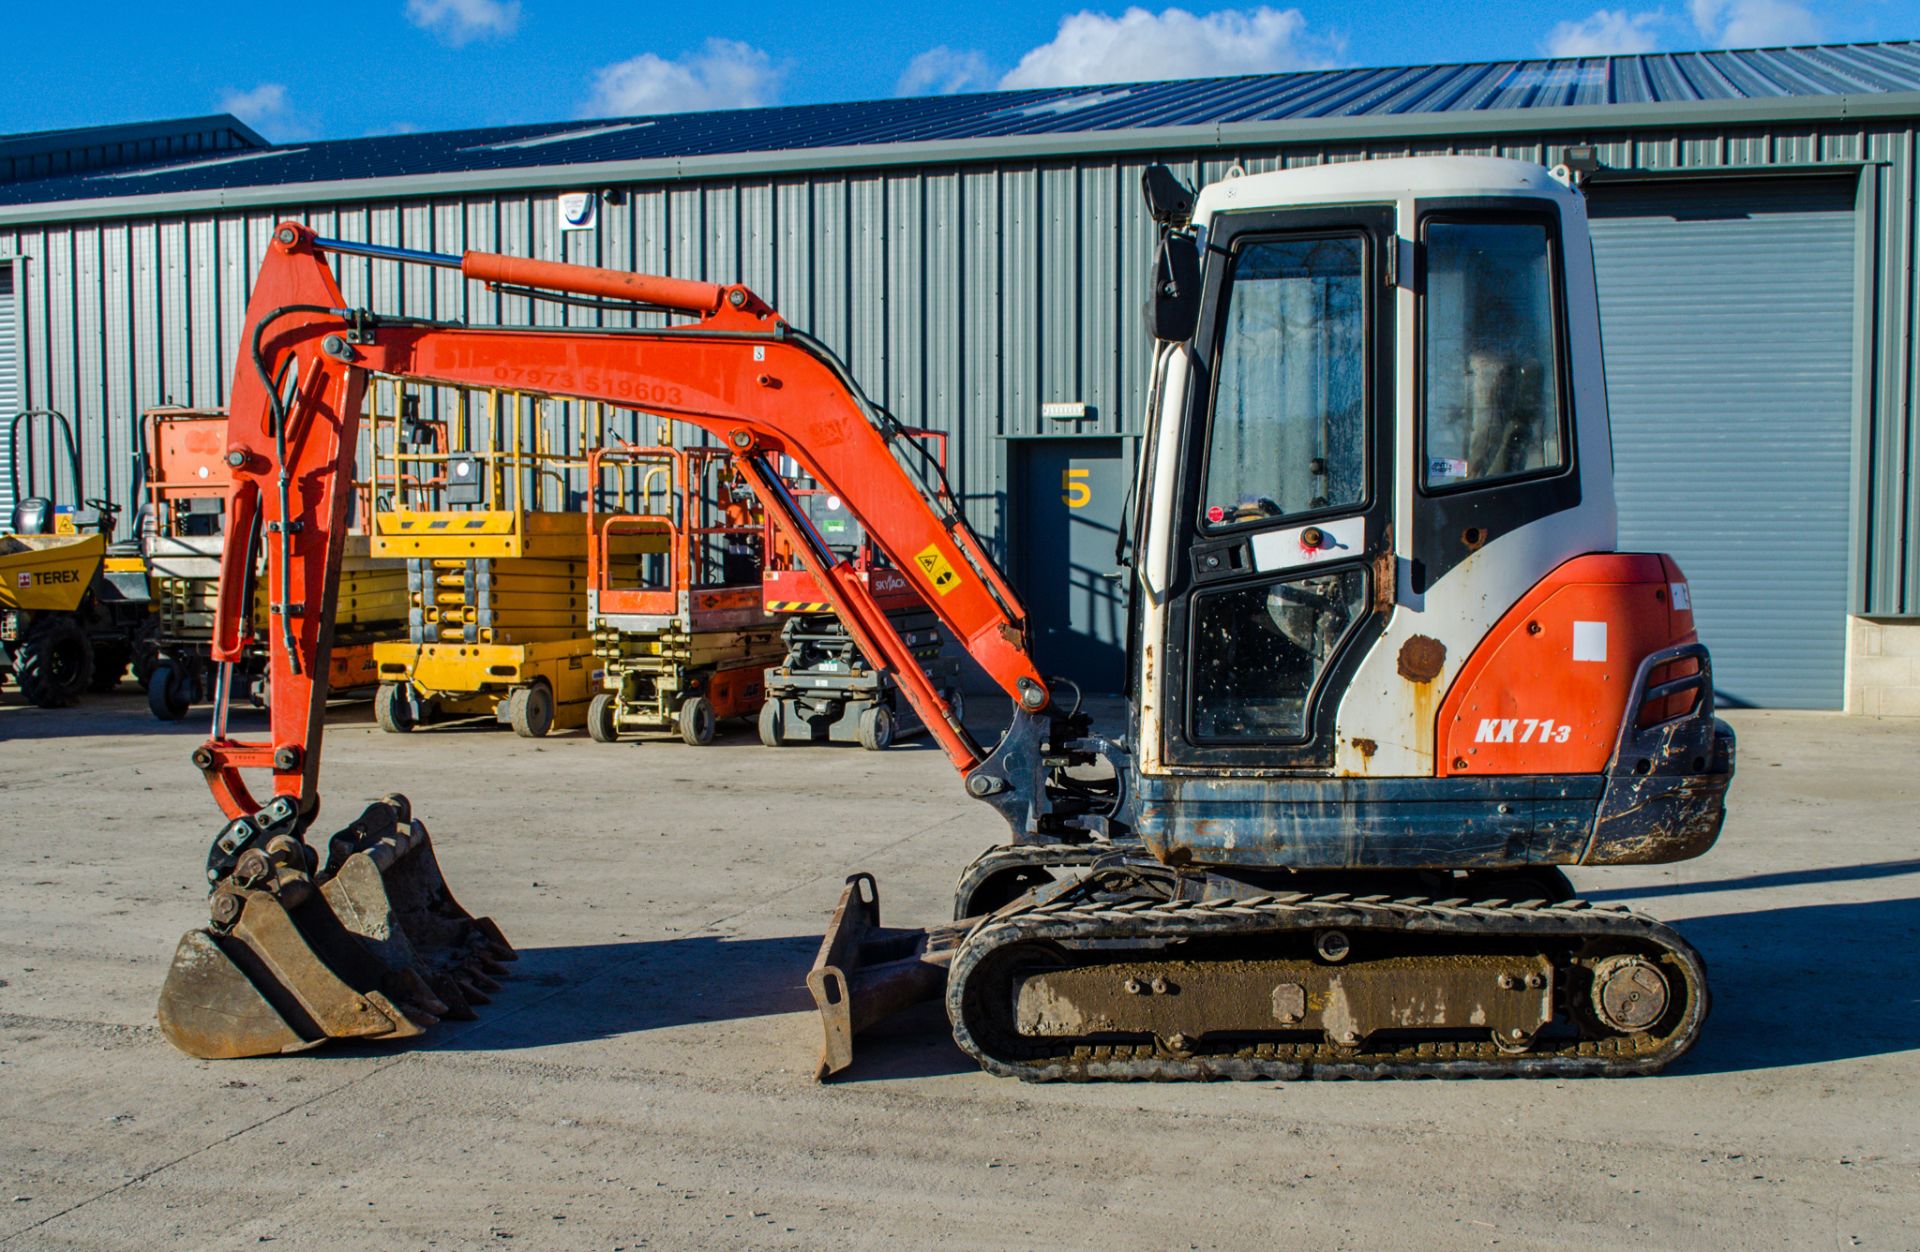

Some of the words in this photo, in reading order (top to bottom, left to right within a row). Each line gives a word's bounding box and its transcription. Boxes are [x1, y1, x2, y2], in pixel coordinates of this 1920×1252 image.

[493, 366, 576, 389] 07973
[585, 375, 683, 406] 519603
[1062, 469, 1091, 508] 5
[34, 571, 80, 585] TEREX
